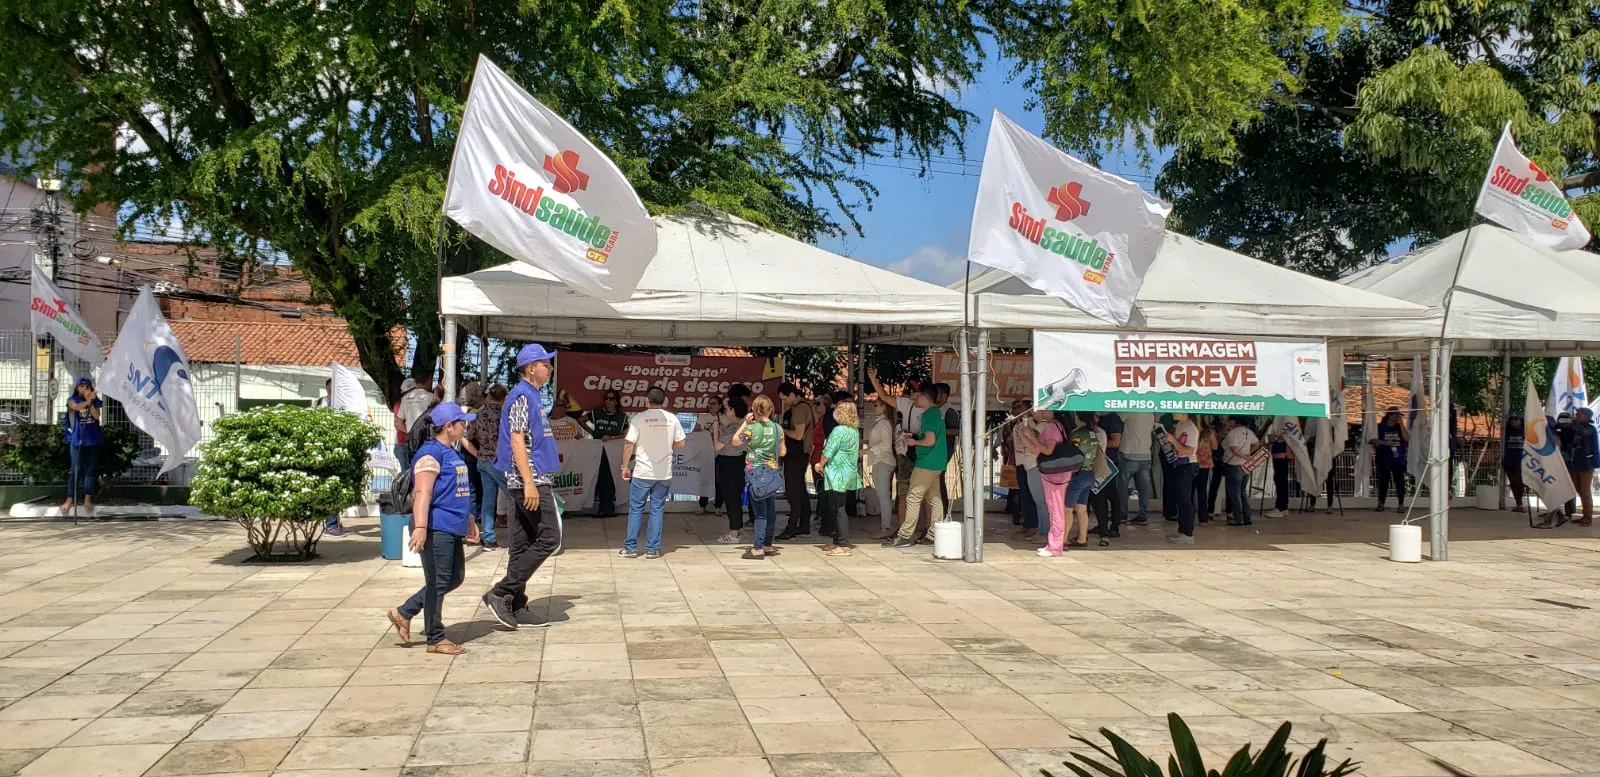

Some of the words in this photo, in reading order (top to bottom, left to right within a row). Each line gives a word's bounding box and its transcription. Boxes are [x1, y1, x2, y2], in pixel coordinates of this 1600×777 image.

[488, 164, 611, 249] Sindsaúde
[1009, 202, 1107, 270] Sindsaúde
[1116, 342, 1255, 358] ENFERMAGEM
[584, 375, 648, 393] Chega
[654, 377, 679, 392] de
[1115, 366, 1156, 387] EM
[1165, 366, 1257, 387] GREVE
[1104, 400, 1128, 409] SEM
[1129, 400, 1157, 411] PISO,
[1160, 400, 1182, 410] SEM
[1184, 401, 1264, 411] ENFERMAGEM!
